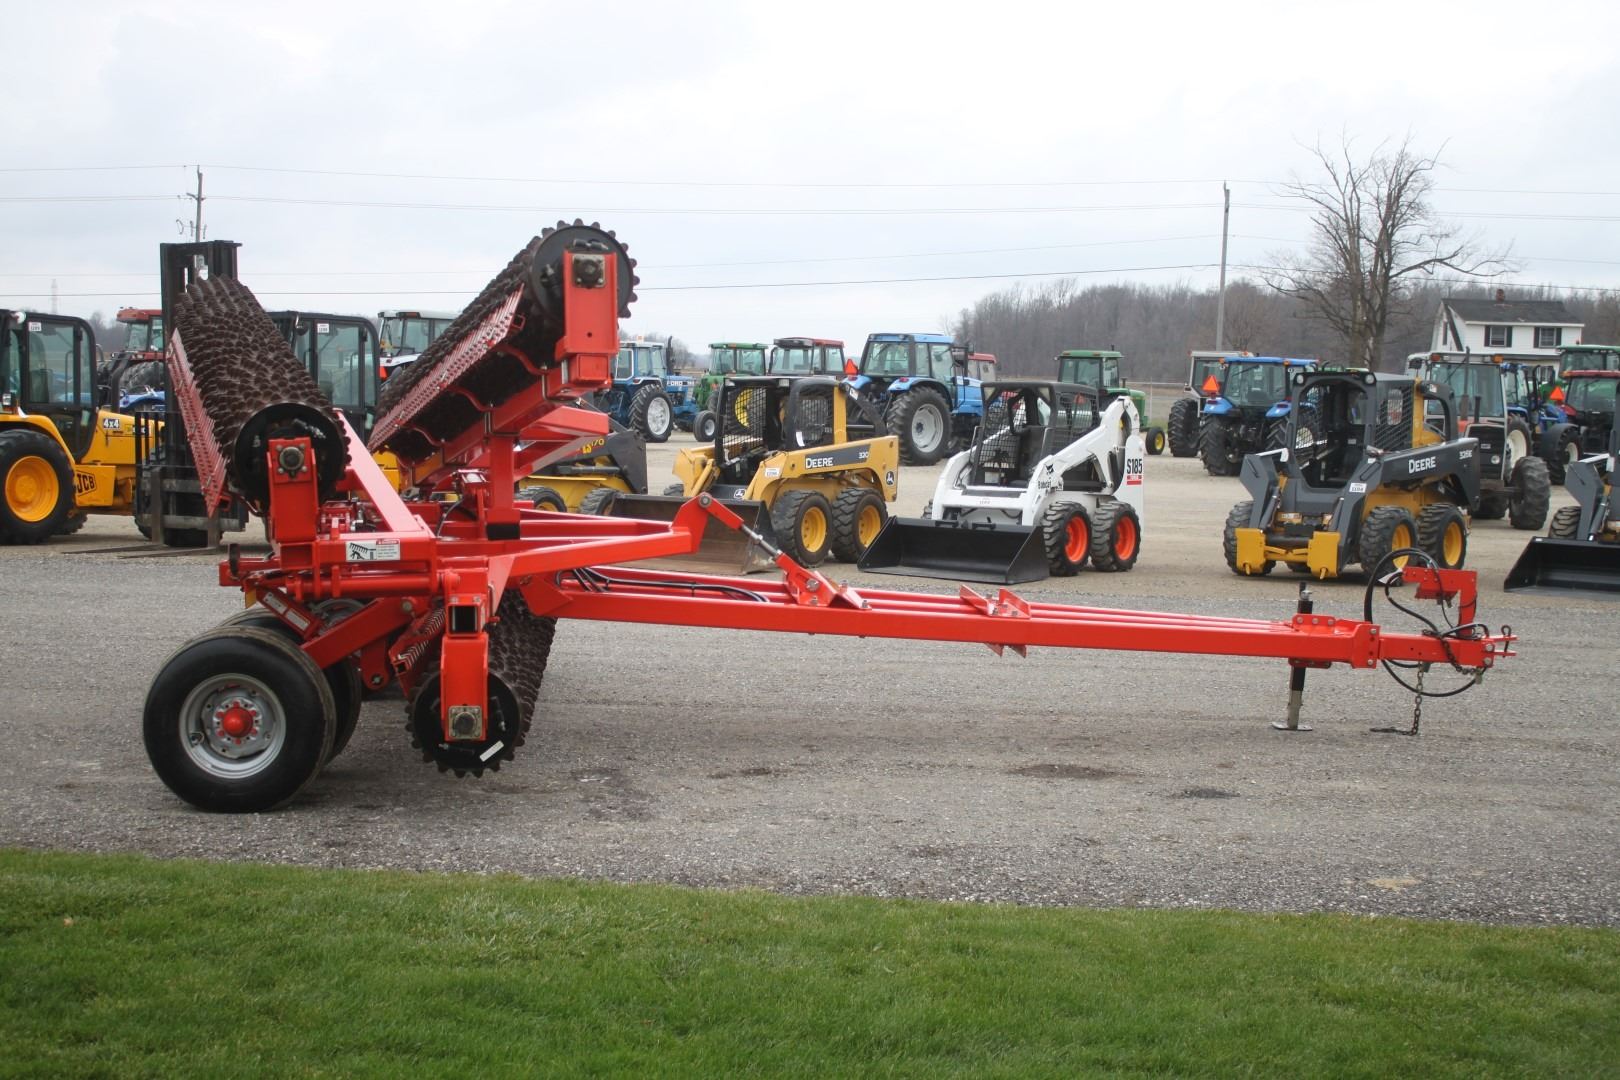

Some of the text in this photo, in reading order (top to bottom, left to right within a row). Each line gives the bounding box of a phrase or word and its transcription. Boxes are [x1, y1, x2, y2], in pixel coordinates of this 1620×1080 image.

[104, 418, 120, 430] 4x4
[806, 457, 834, 470] DEERE
[1126, 458, 1143, 475] S185
[1408, 456, 1436, 474] DEERE
[77, 473, 95, 494] JCB
